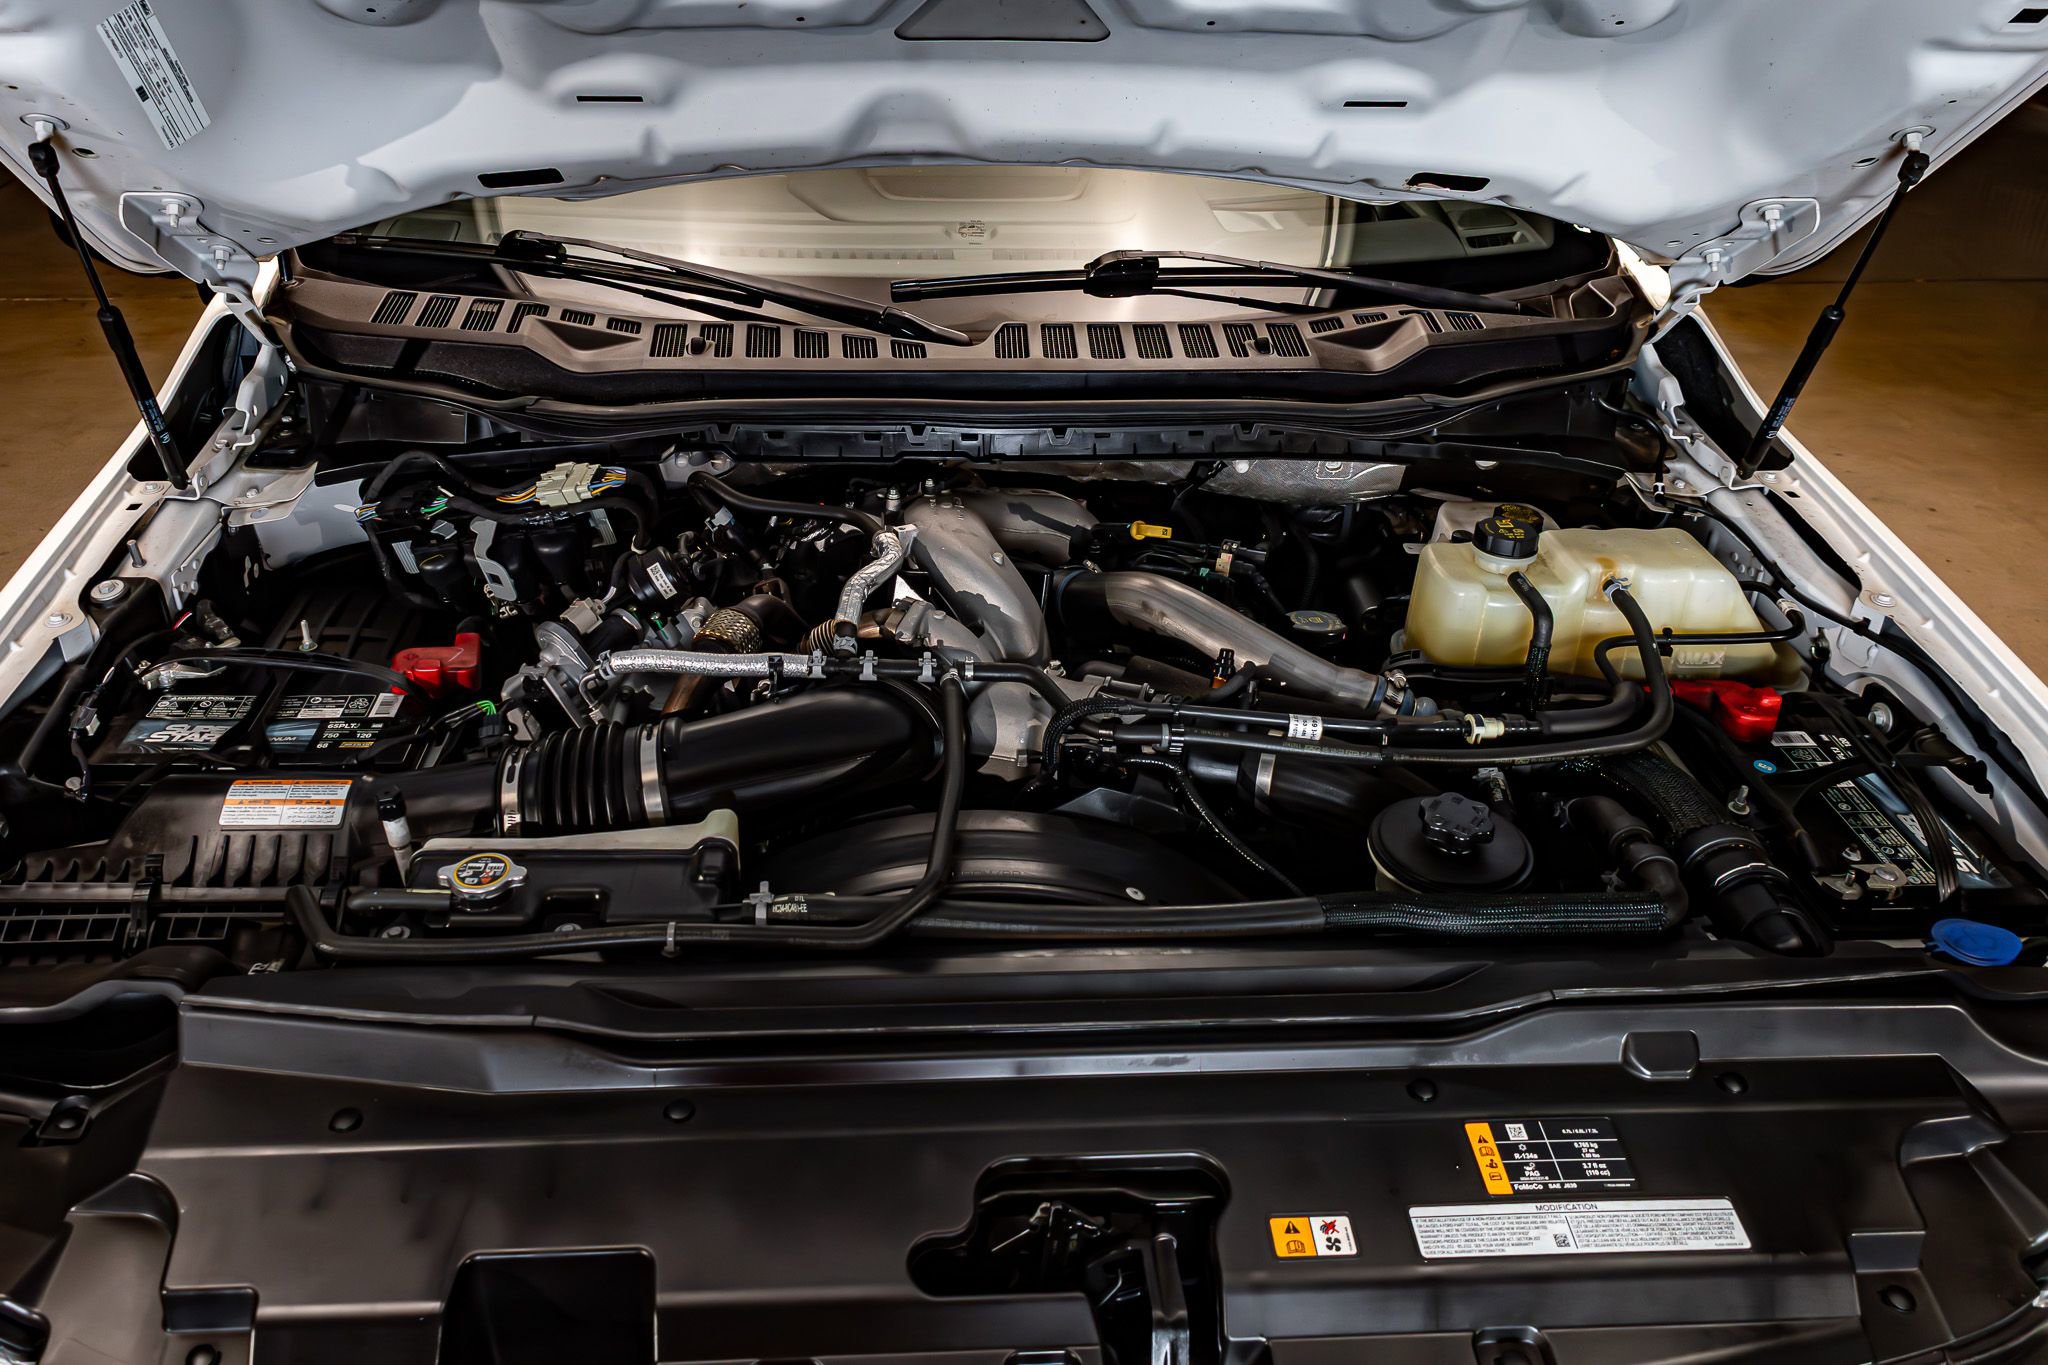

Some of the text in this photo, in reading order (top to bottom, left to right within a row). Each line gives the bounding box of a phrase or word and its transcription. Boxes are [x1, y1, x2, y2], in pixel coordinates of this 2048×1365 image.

[1687, 652, 1724, 665] MAX
[165, 723, 232, 732] SUPE
[144, 731, 221, 743] STAR
[1535, 1203, 1598, 1211] MODIFICATION
